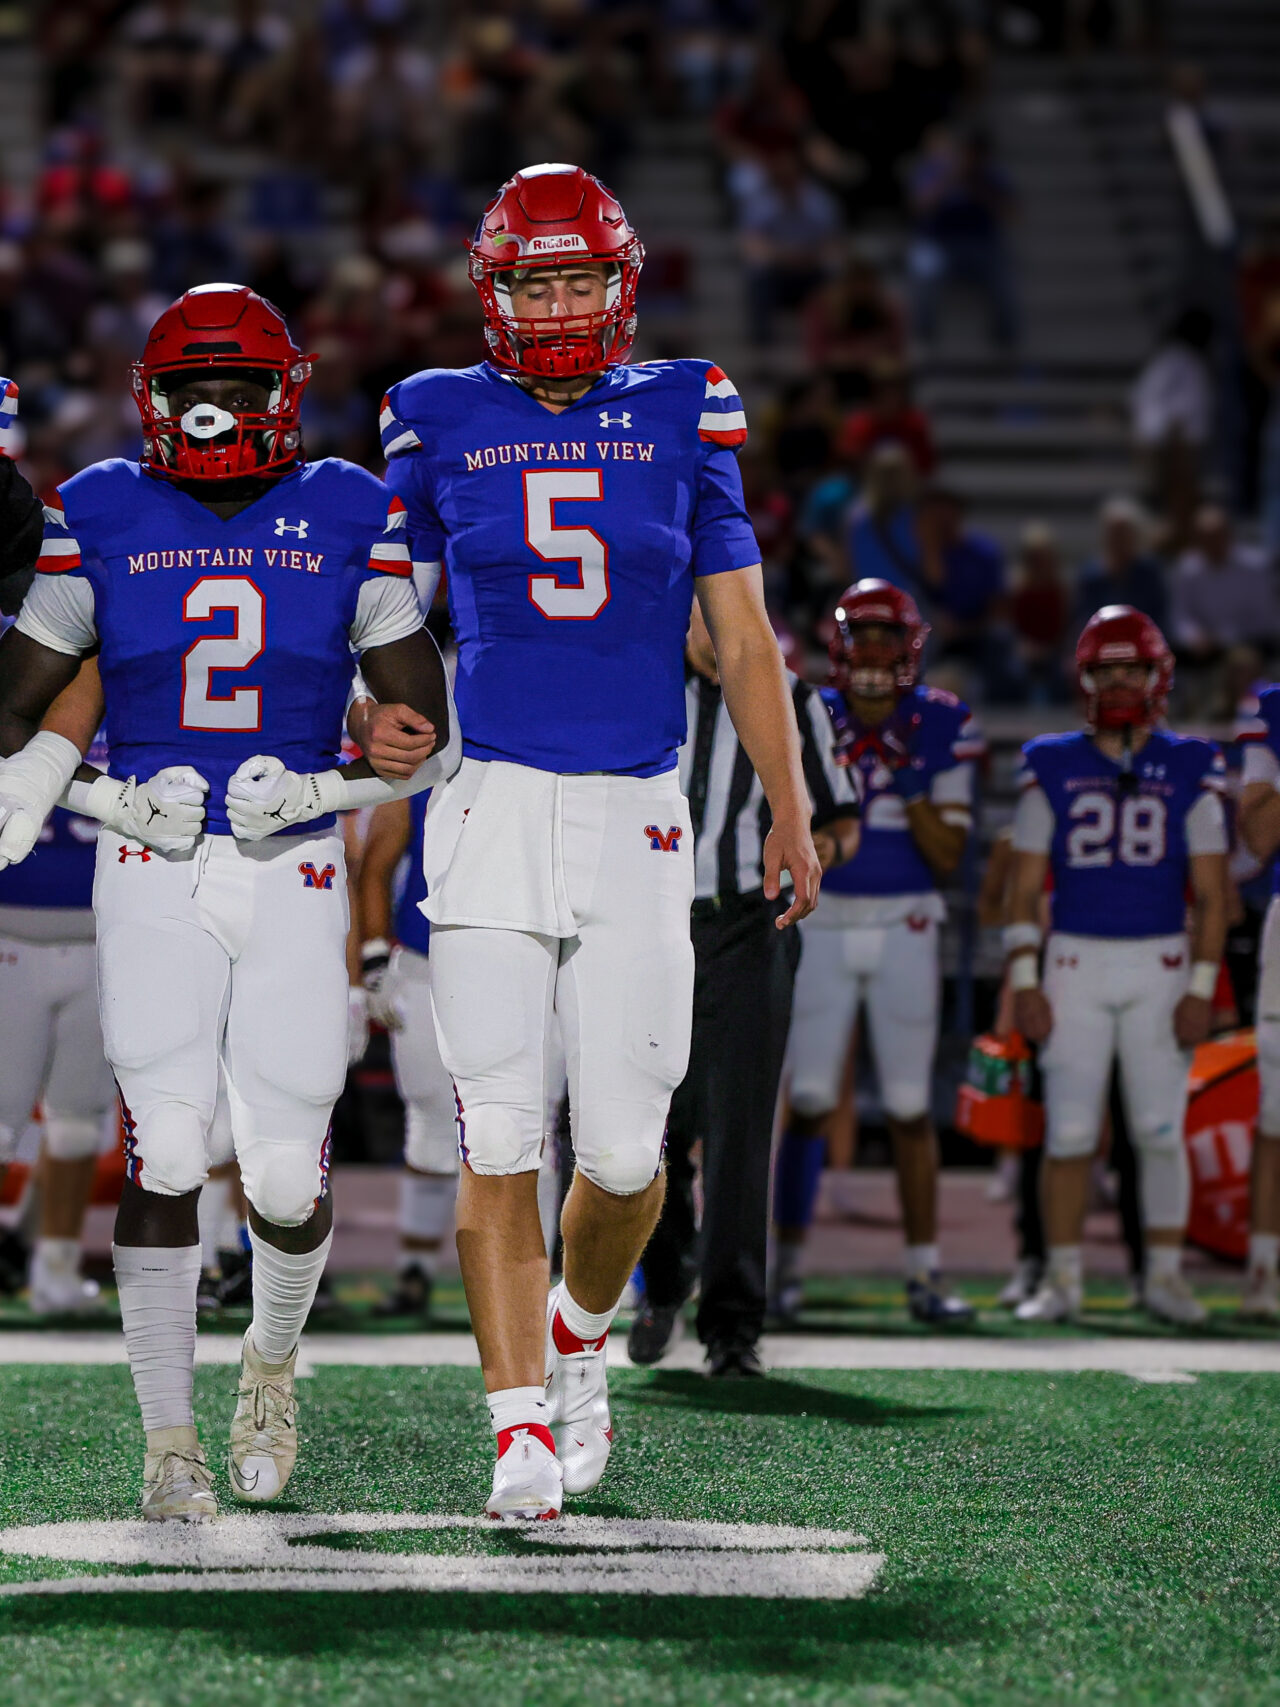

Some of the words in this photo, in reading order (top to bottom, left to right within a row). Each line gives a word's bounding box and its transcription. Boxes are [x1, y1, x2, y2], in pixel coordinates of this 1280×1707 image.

[533, 237, 579, 250] Riddell
[463, 441, 587, 472] MOUNTAIN
[595, 441, 655, 463] VIEW
[128, 547, 255, 575] MOUNTAIN
[263, 548, 324, 574] VIEW
[522, 467, 611, 621] 5
[179, 574, 266, 733] 2
[1066, 791, 1169, 869] 28
